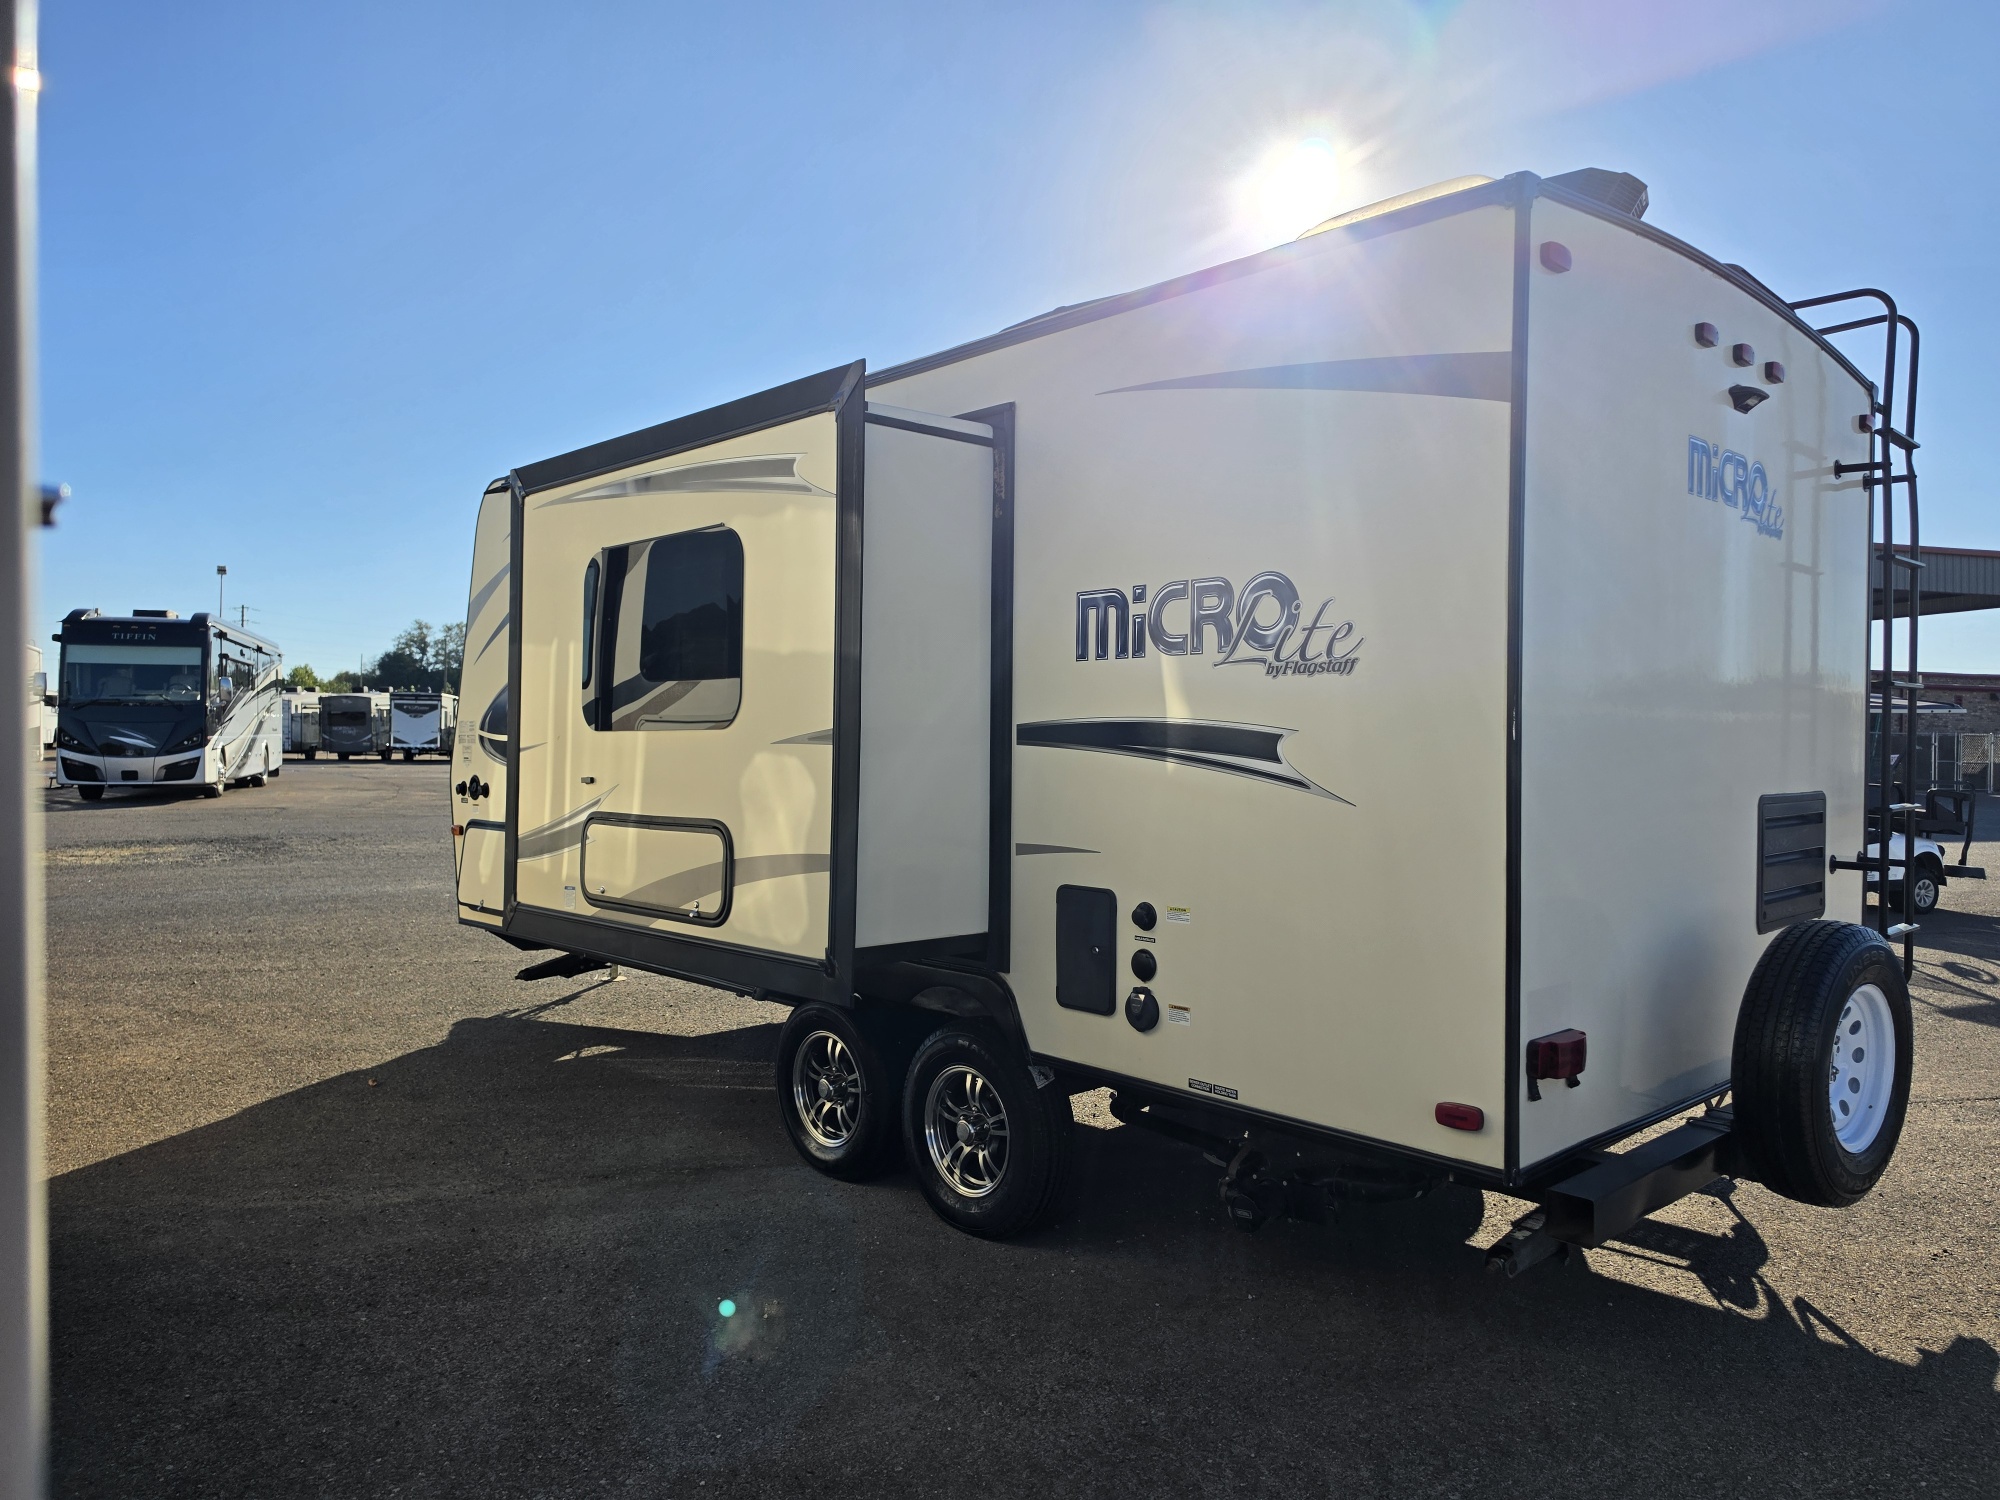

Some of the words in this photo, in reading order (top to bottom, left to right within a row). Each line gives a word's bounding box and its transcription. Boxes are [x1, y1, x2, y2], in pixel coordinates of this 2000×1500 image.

[111, 632, 157, 641] TIFFIN
[1213, 590, 1365, 668] Lite
[1265, 661, 1283, 678] by
[1281, 657, 1359, 676] Flagstaff
